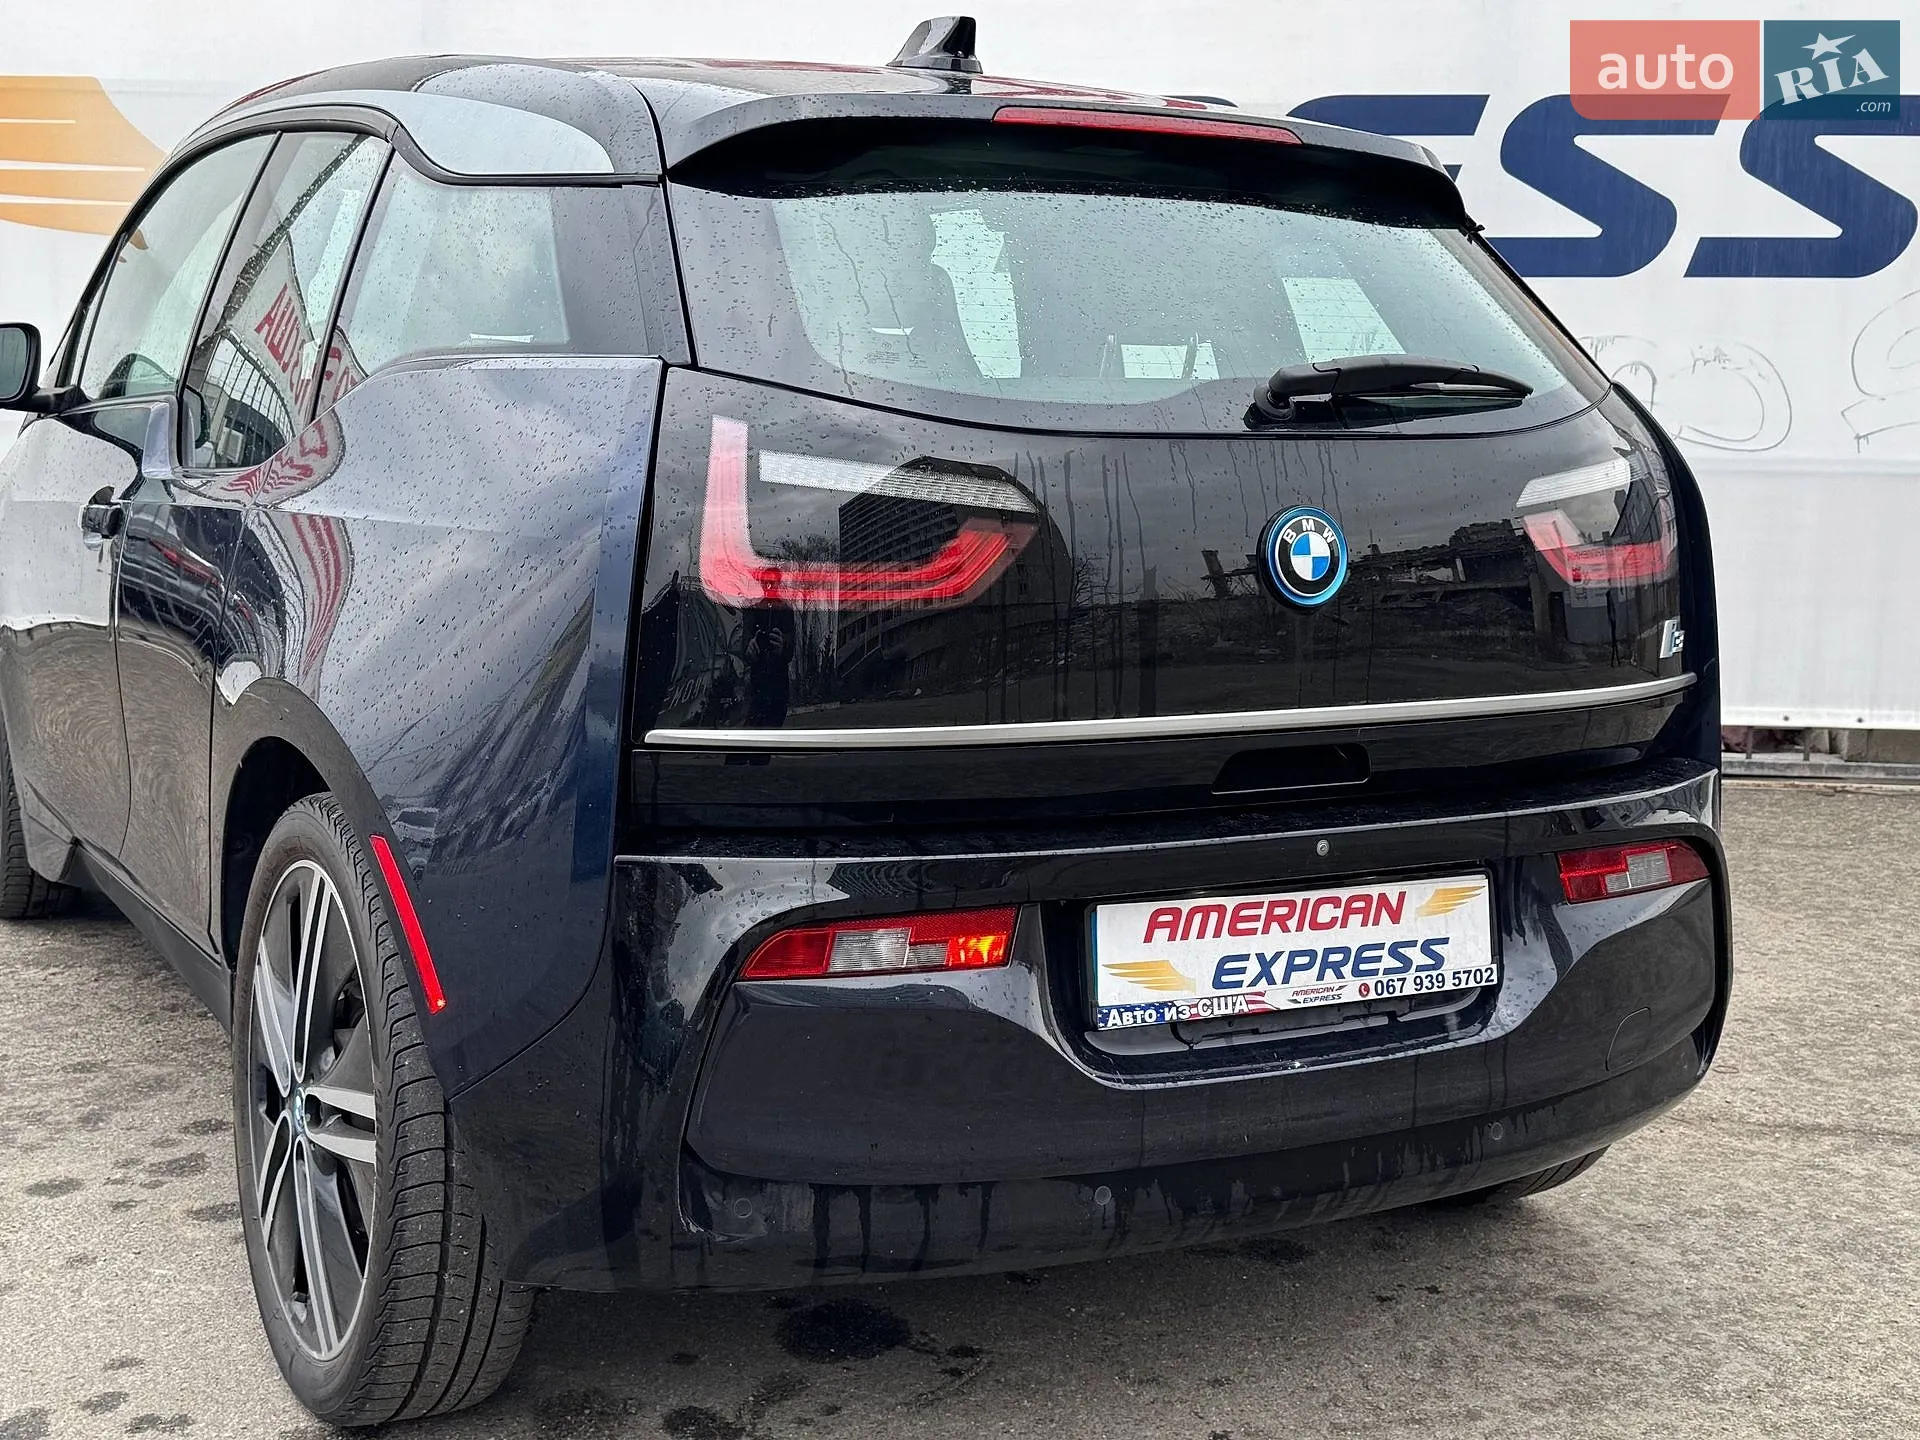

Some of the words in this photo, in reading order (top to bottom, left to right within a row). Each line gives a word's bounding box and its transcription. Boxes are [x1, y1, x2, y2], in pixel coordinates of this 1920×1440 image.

[1282, 518, 1337, 545] BMW
[1143, 891, 1406, 944] AMERICAN
[1211, 937, 1451, 990] EXPRESS
[1291, 985, 1335, 998] AMERICAN
[1374, 977, 1408, 997] 067
[1413, 972, 1446, 992] 939
[1451, 967, 1495, 987] 5702
[1197, 994, 1250, 1018] США
[1302, 993, 1343, 1004] EXPRESS
